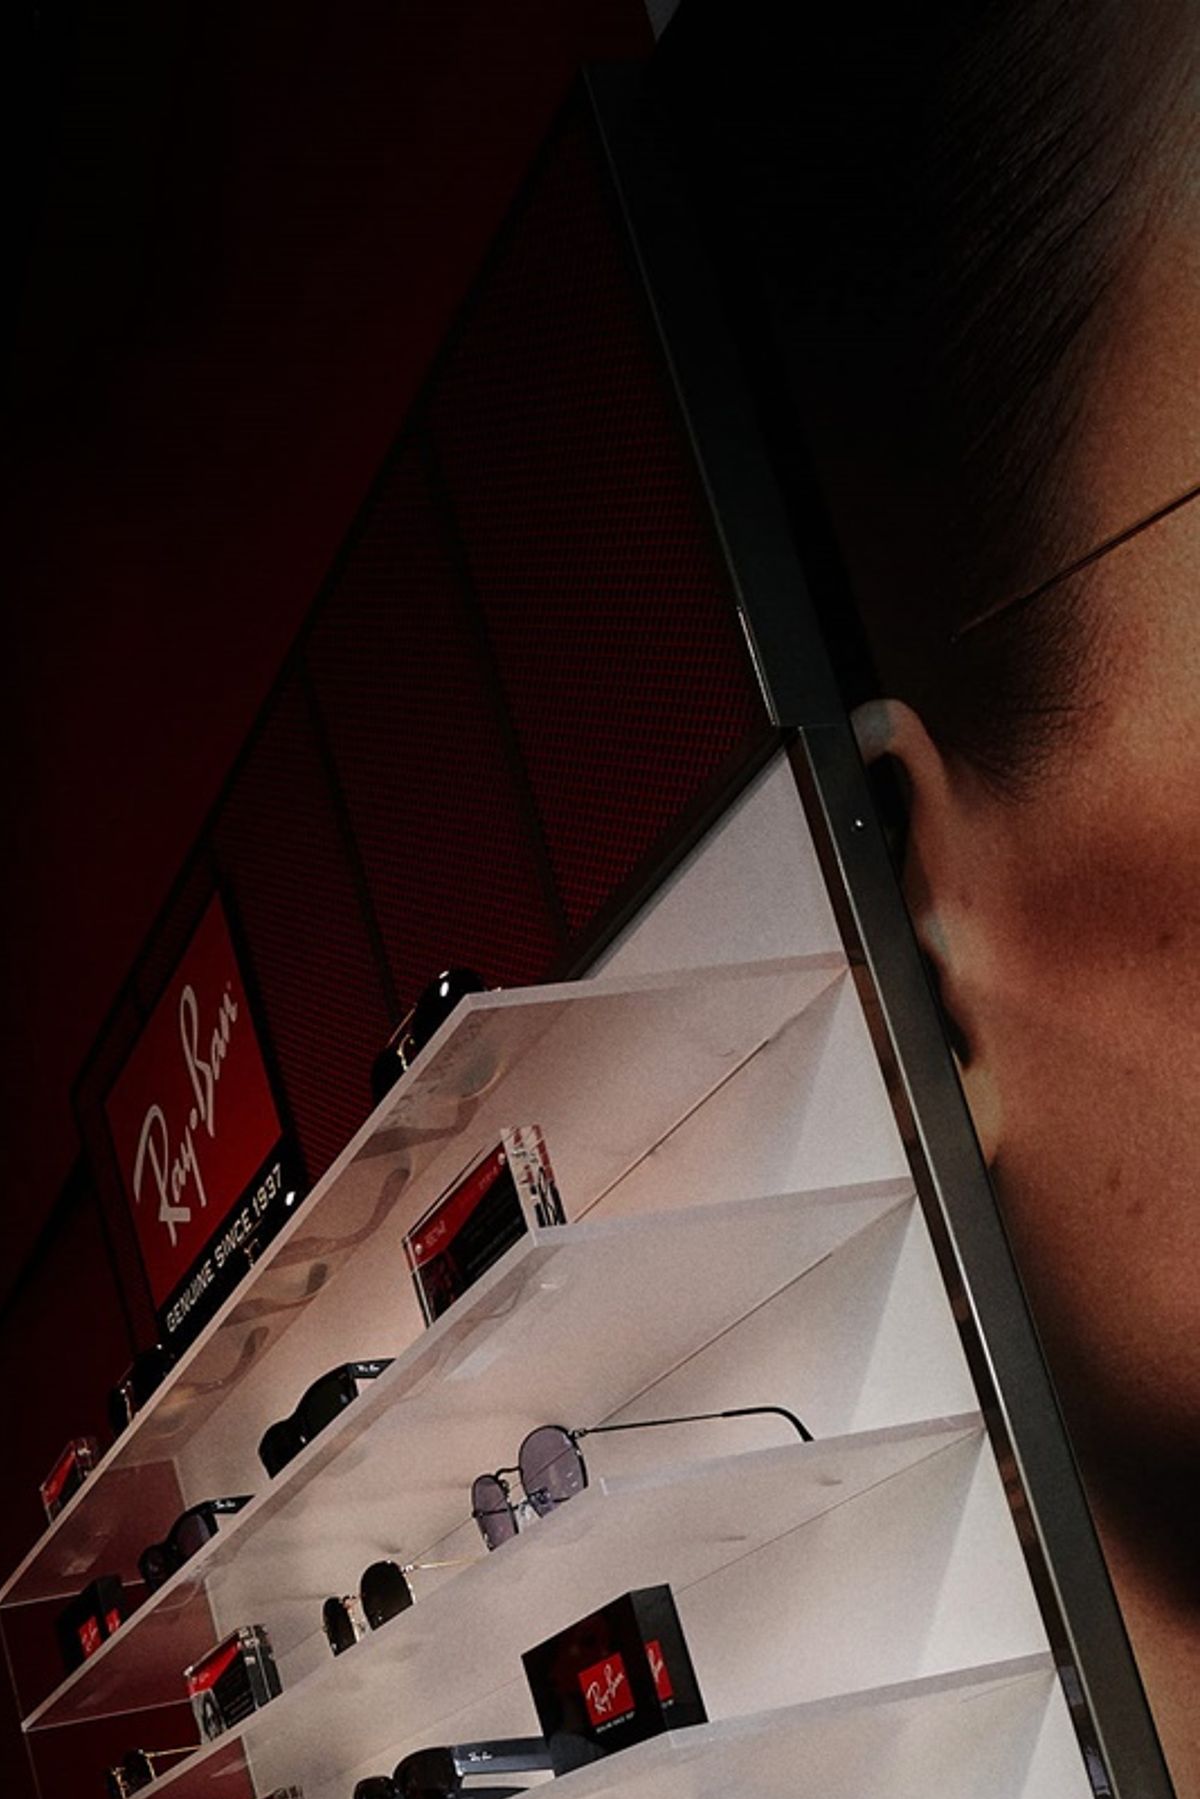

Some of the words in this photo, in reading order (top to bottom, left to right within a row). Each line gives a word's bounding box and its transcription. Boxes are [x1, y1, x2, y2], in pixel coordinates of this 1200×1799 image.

[166, 1259, 215, 1333] GENUINE
[214, 1207, 252, 1268] SINCE
[252, 1162, 282, 1218] 1937
